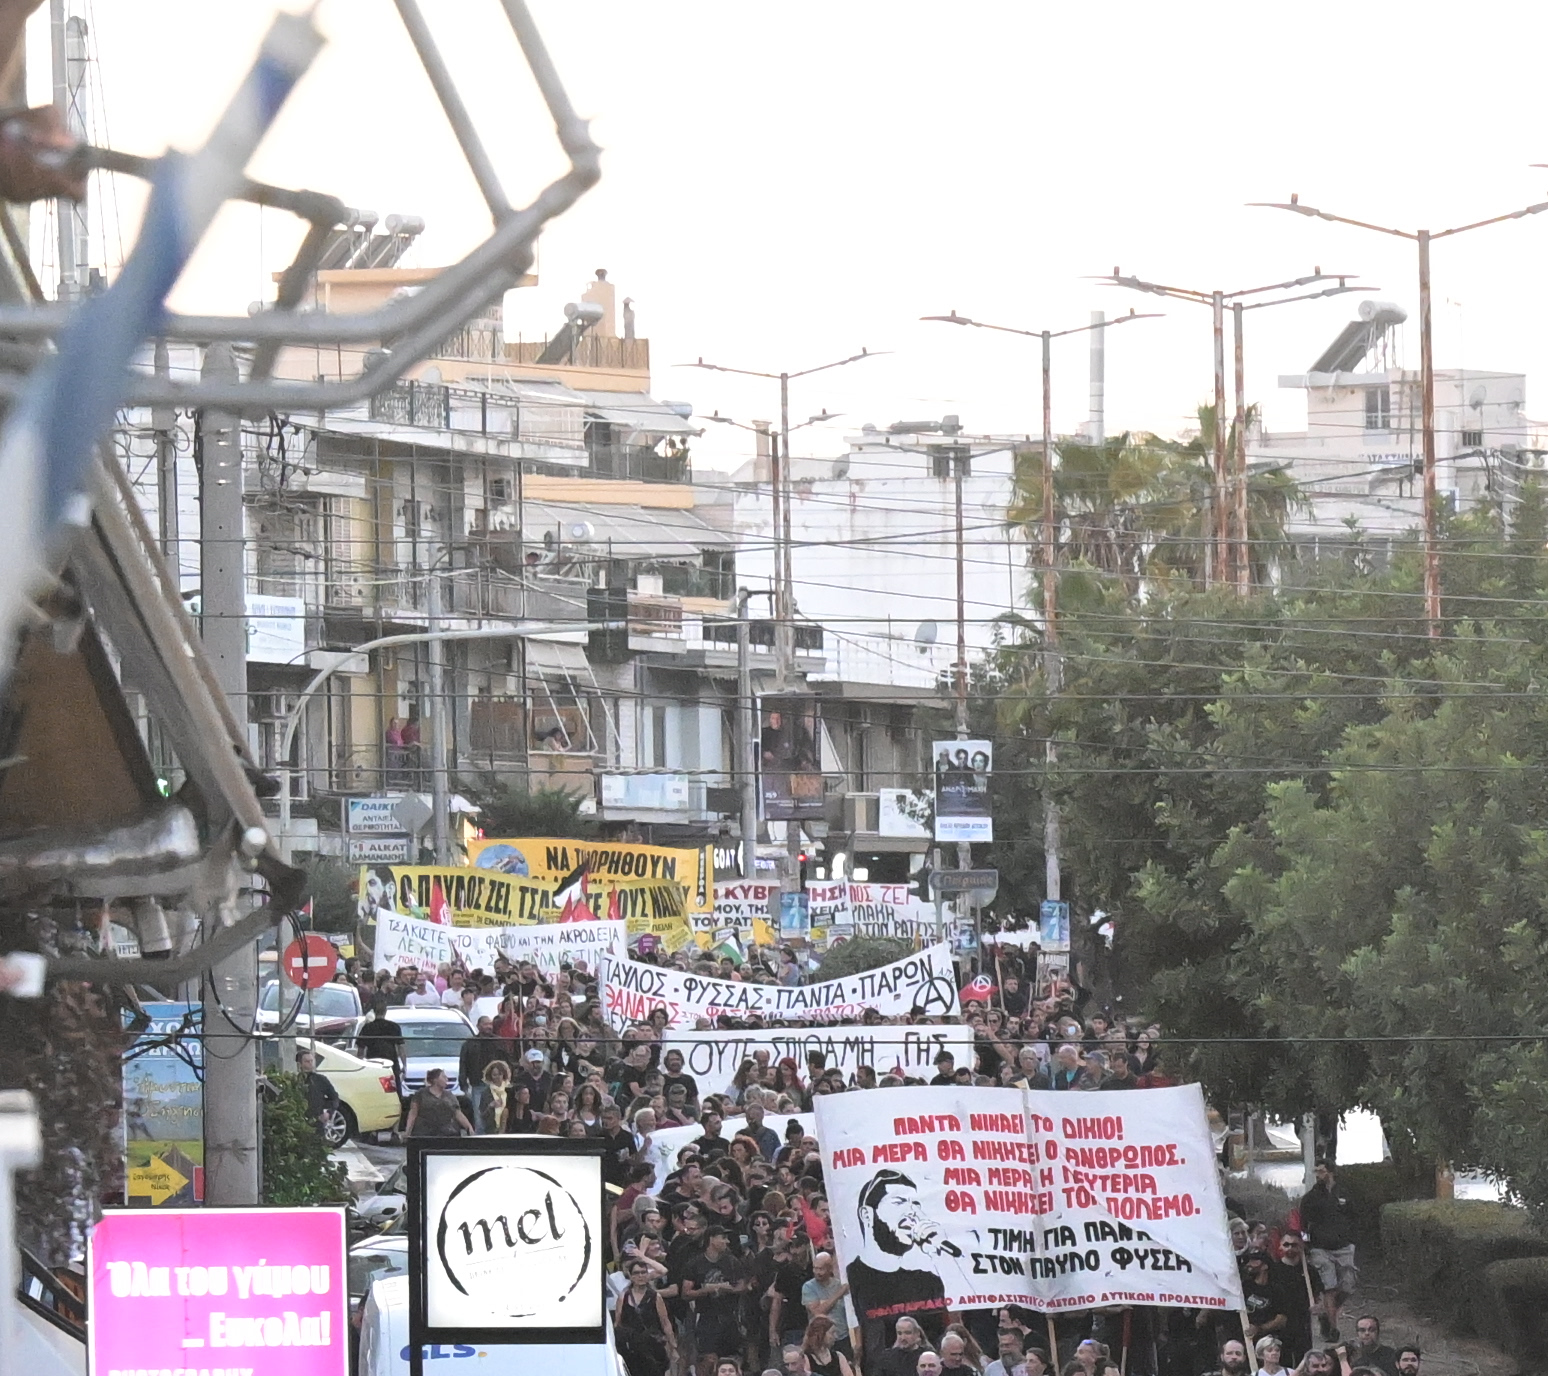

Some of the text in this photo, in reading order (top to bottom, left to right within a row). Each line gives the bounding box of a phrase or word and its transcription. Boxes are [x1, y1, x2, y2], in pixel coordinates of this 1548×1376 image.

[361, 802, 397, 811] DAIKI
[545, 847, 571, 871] ΝΑ
[388, 919, 447, 944] ΤΣΑΚΙΣΤΕ
[558, 926, 620, 945] ΑΚΡΟΔΕΞΙΑ
[683, 977, 763, 1011] ΦΥΣΣΑΣ
[776, 983, 846, 1009] ΠΑΝΤΑ
[858, 955, 934, 1000] ΠΑΡΩΝ
[893, 1113, 1124, 1140] ΠΑΝΤΑ ΝΙΚΑΕΙ ΤΟ ΔΙΚΙΟ!
[832, 1140, 1186, 1170] ΜΙΑ ΜΕΡΑ ΘΑ ΝΙΚΗΣΕΙ Ο ΑΝΘΡΩΠΟΣ.
[943, 1168, 980, 1187] ΜΙΑ
[988, 1168, 1032, 1188] ΜΕΡΑ
[1039, 1169, 1054, 1187] Η
[944, 1186, 1201, 1221] ΘΑ ΝΙΚΗΣΕΙ ΤΟ ΠΟΛΕΜΟ.
[988, 1227, 1034, 1252] ΤΙΜΗ
[1043, 1223, 1075, 1251] ΓΙΑ
[972, 1246, 1193, 1280] ΣΤΟΝ ΠΑΥΛΟ ΦΥΣΣΑ
[174, 1266, 228, 1296] του
[233, 1258, 330, 1299] γάμου
[1100, 1291, 1156, 1303] ΔΥΤΙΚΩΝ
[1158, 1292, 1227, 1307] ΠΡΟΑΣΤΙΩΝ
